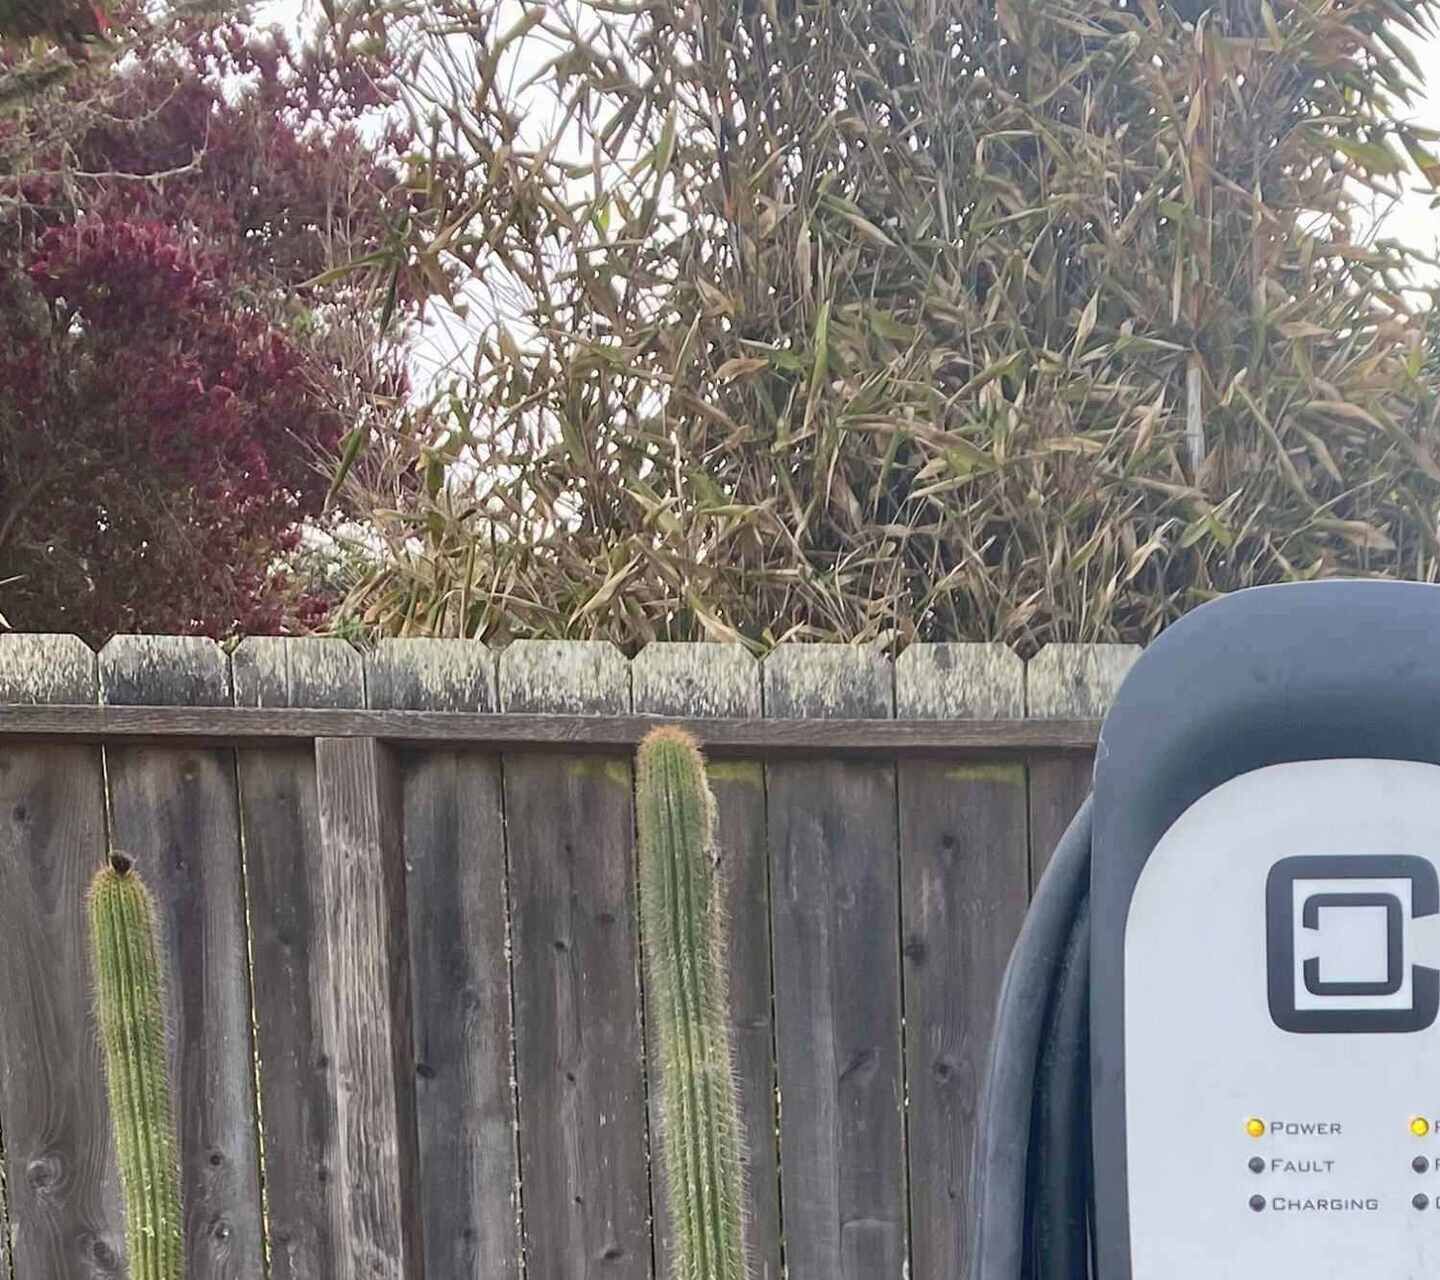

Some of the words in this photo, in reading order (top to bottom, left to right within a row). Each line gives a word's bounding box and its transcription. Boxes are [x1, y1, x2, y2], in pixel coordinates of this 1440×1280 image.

[1270, 1121, 1342, 1136] POWER
[1270, 1158, 1335, 1173] FAULT
[1271, 1196, 1379, 1211] CHARGING
